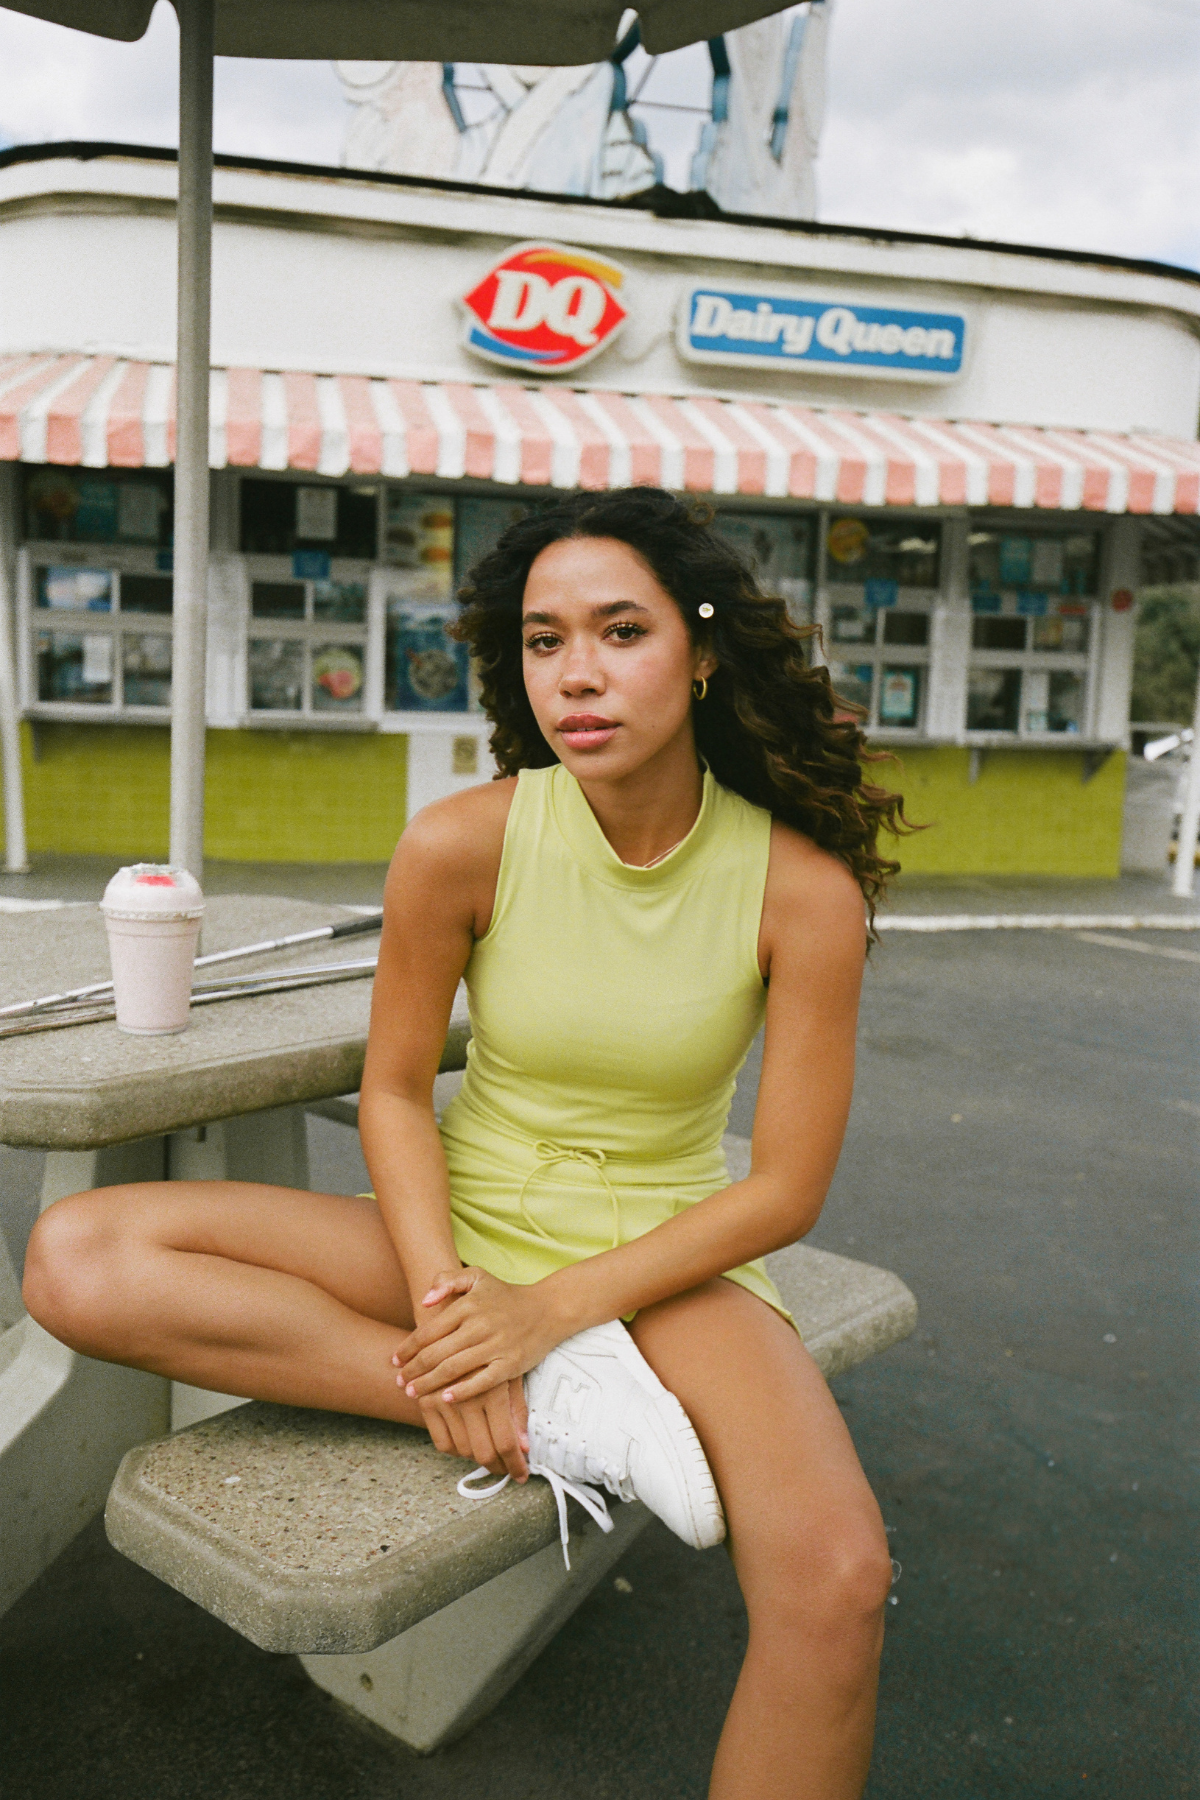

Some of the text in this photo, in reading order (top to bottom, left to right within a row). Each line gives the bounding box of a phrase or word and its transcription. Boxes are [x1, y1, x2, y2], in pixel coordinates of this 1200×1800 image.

[487, 269, 607, 346] DQ
[691, 294, 956, 359] Dairy Queen
